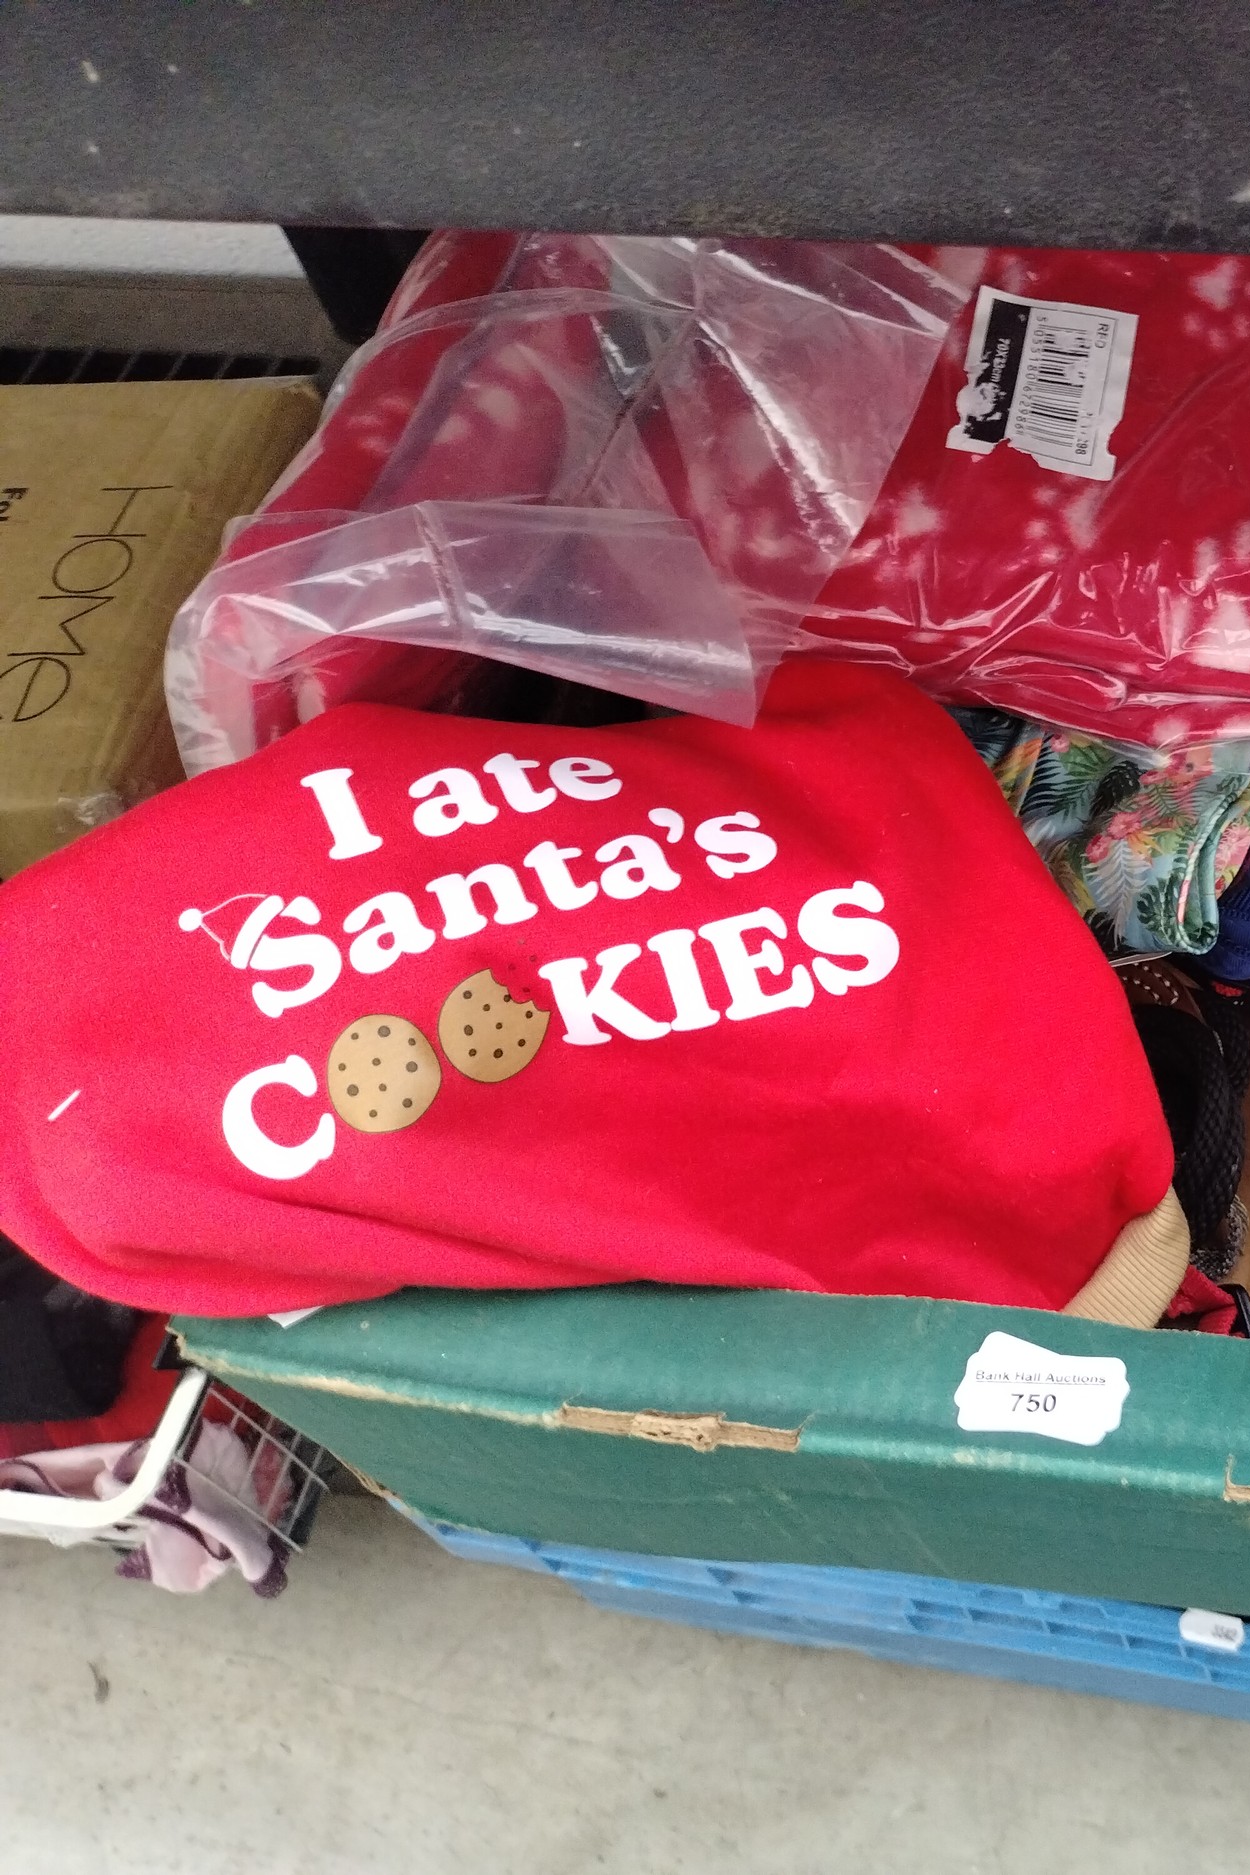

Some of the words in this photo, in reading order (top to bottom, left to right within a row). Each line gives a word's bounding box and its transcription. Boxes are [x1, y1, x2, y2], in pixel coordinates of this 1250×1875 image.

[300, 767, 384, 862] I
[407, 752, 624, 837] ate
[245, 807, 778, 1019] Santa's
[974, 1369, 1010, 1382] Bank
[1014, 1371, 1041, 1383] Hall
[1045, 1372, 1107, 1384] Auctions
[1010, 1392, 1057, 1412] 750
